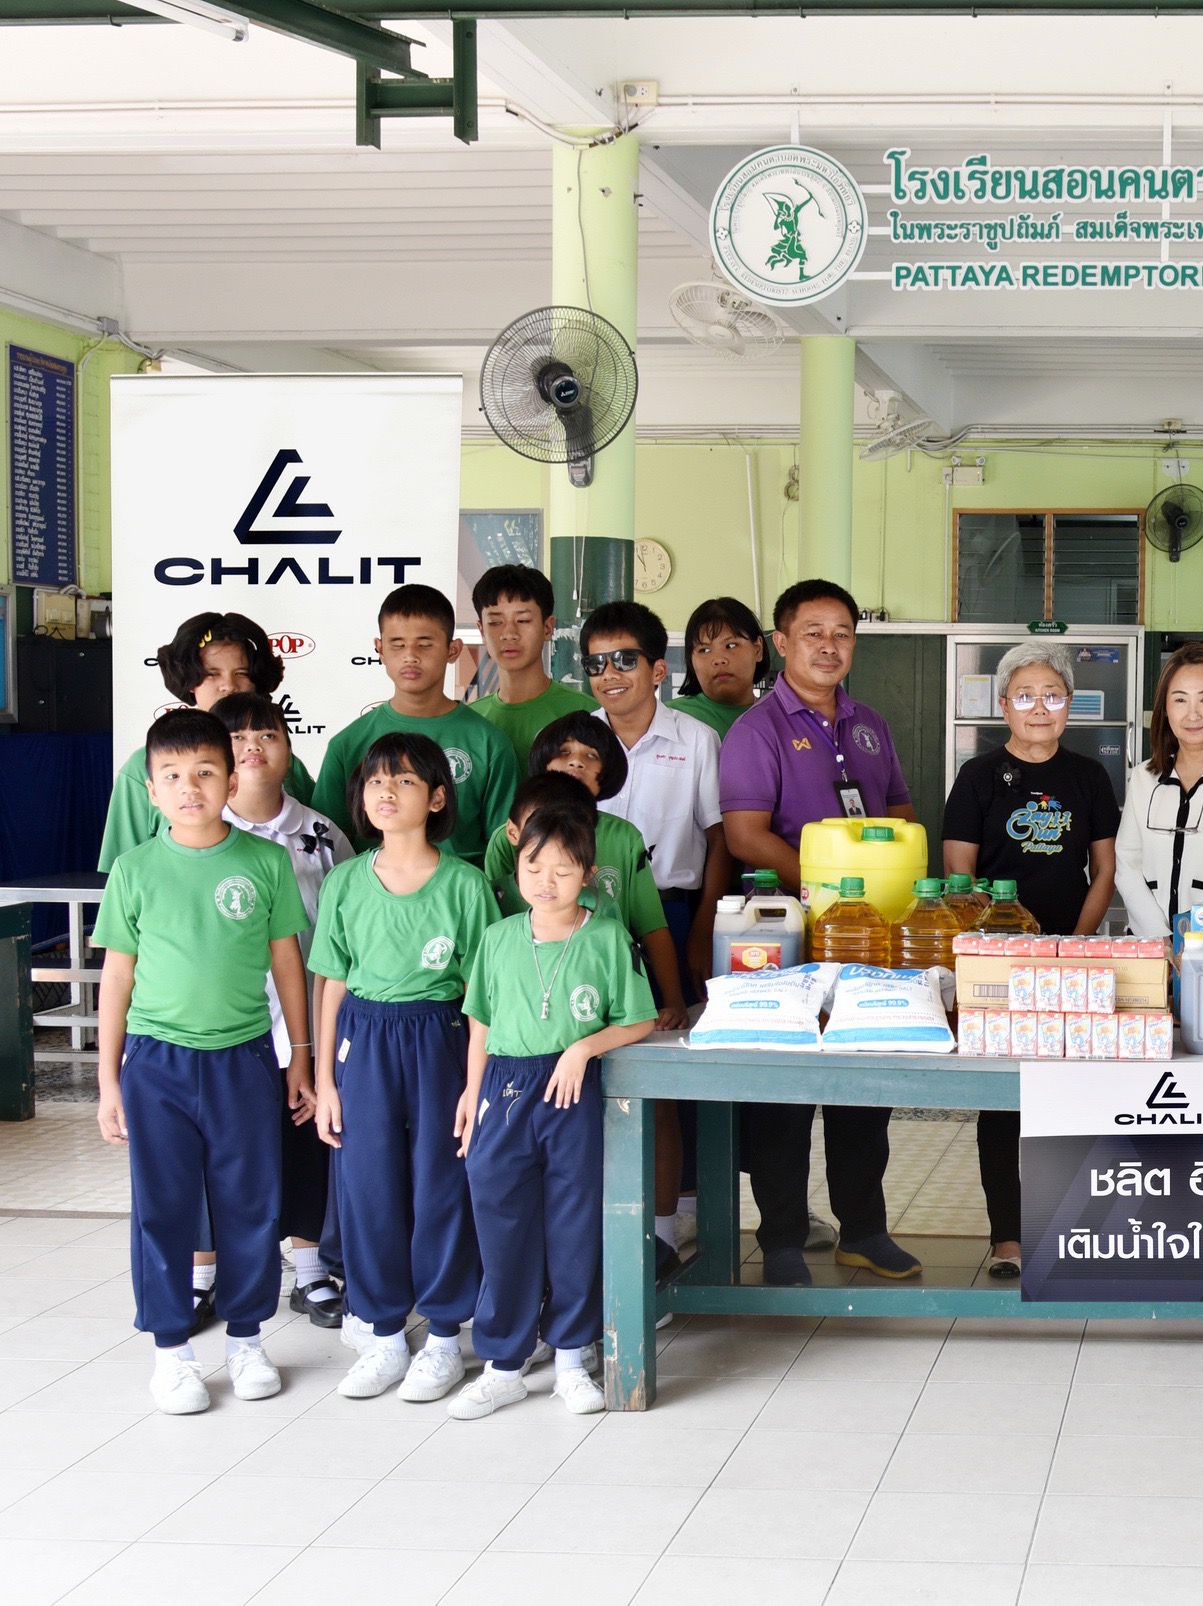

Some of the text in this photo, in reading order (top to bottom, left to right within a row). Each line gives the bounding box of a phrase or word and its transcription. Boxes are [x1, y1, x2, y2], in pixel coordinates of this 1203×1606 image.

[889, 211, 1061, 250] ในพระราชูปถัมภ์
[895, 265, 1015, 287] PATTAYA
[154, 557, 421, 586] CHALIT
[1090, 1161, 1171, 1197] ชลิต
